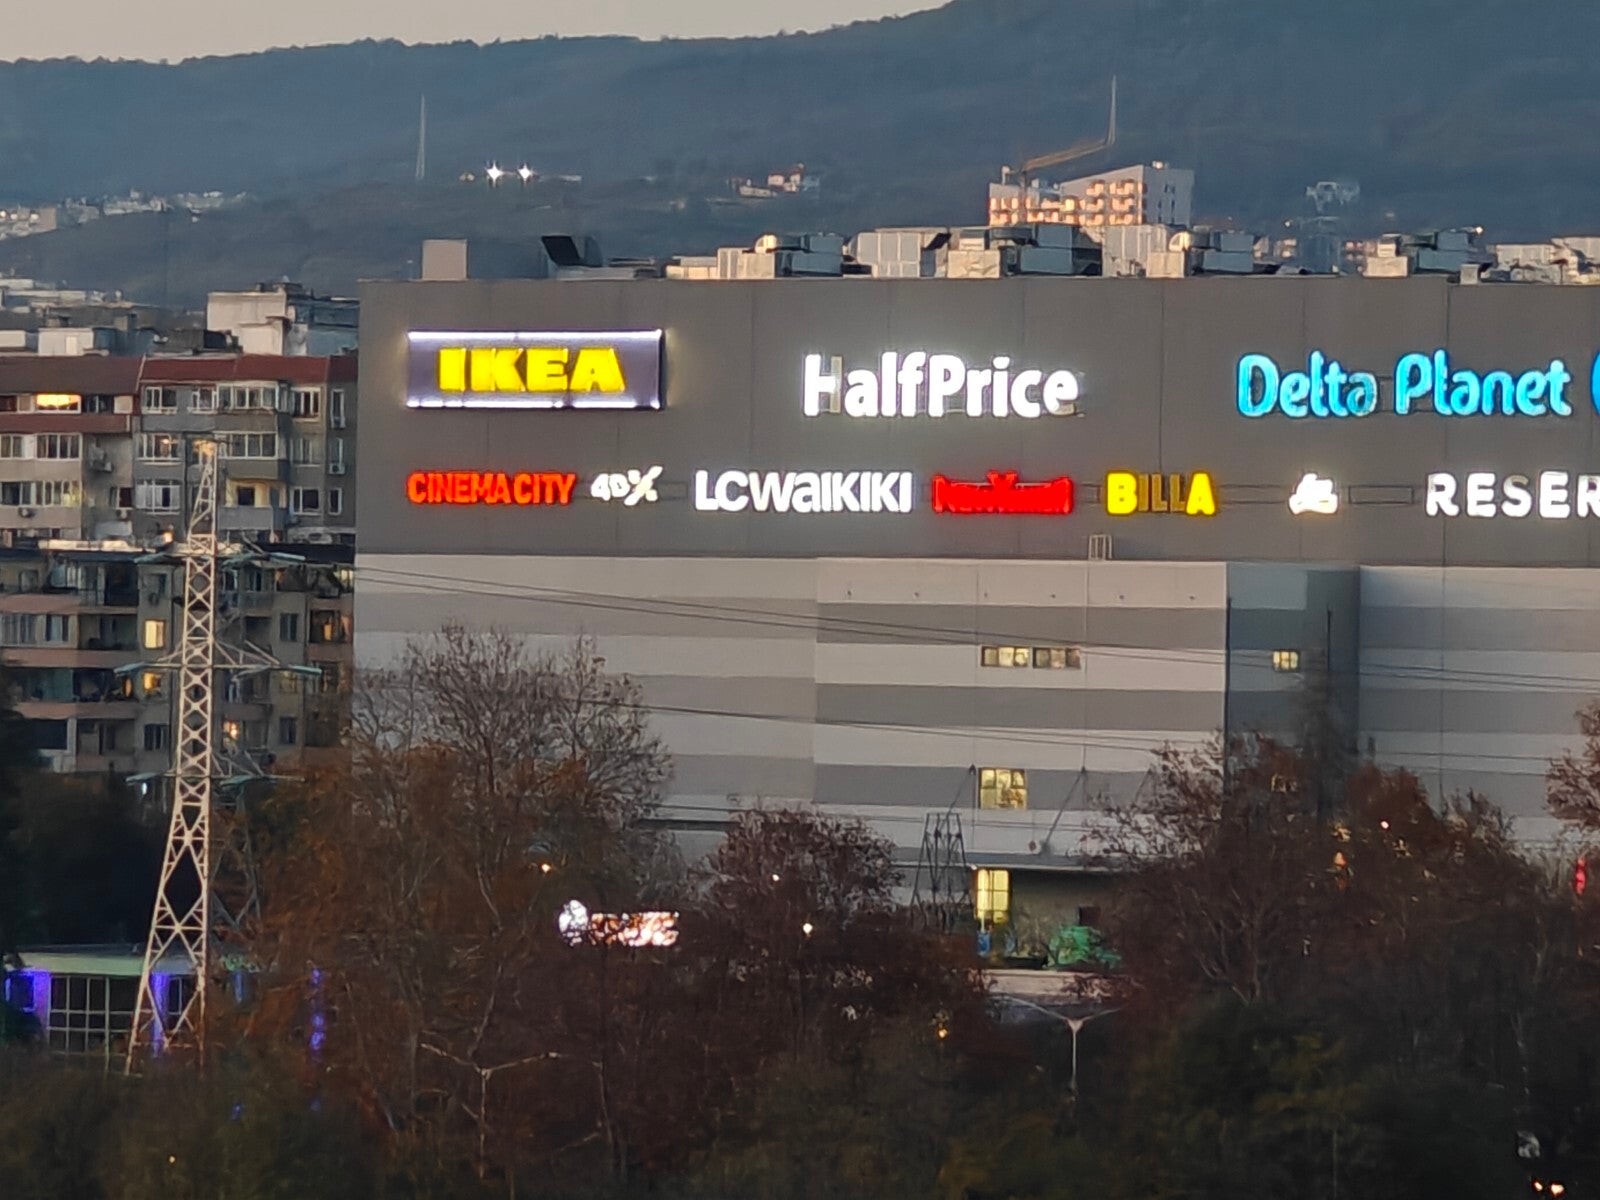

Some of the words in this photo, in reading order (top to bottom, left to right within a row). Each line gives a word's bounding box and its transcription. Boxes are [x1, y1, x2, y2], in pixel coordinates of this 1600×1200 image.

[438, 346, 627, 394] IKEA
[803, 351, 1079, 418] HalfPrice
[1237, 350, 1378, 418] Delta
[1393, 348, 1573, 416] Planet
[1106, 471, 1216, 515] BILLA
